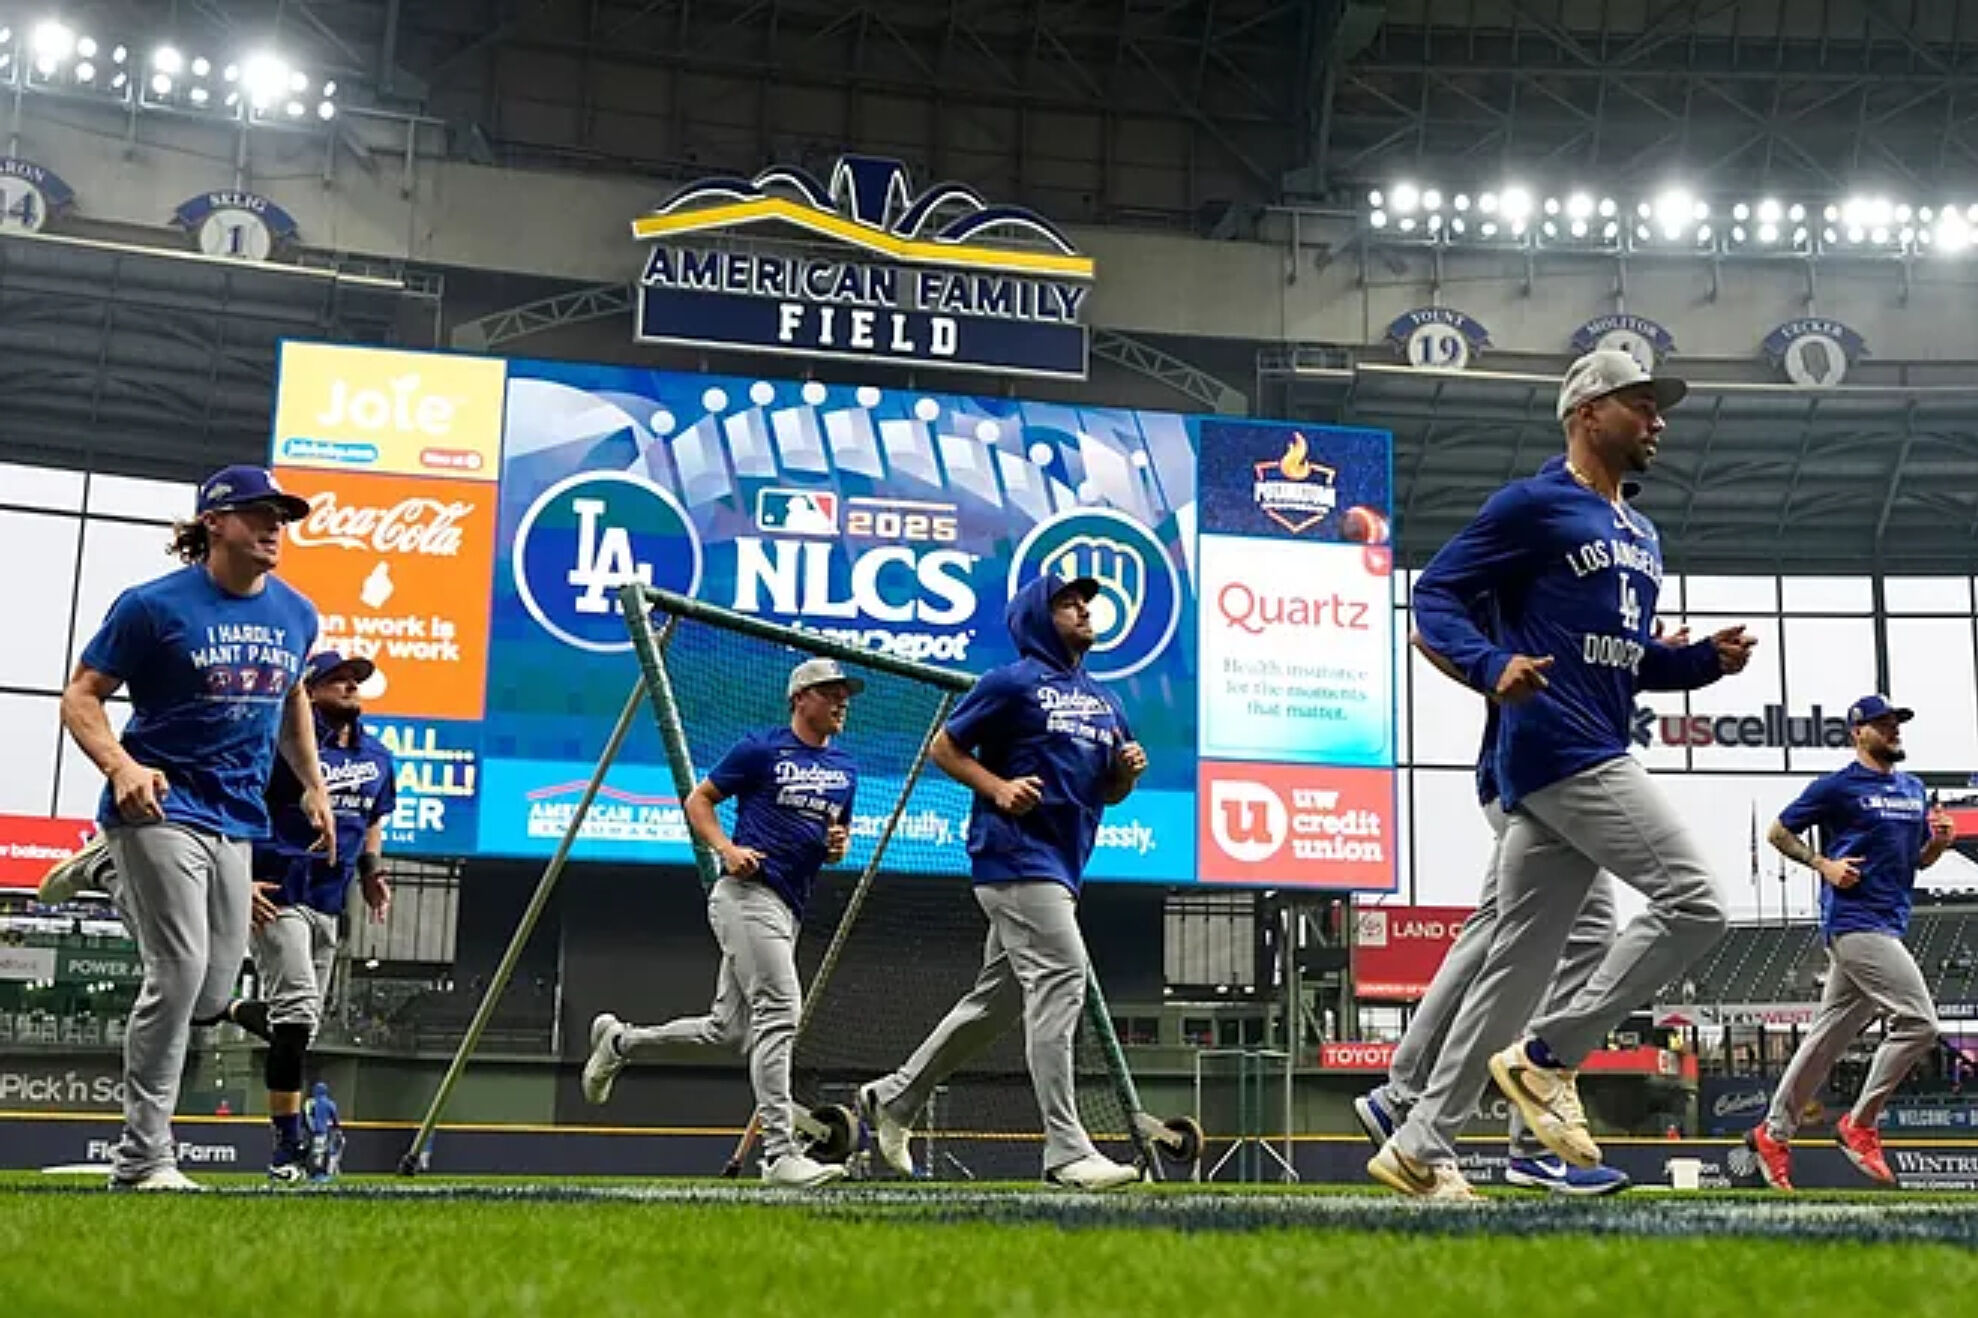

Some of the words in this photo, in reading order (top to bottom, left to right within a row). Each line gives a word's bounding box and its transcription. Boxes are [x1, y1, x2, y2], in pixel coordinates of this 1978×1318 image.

[230, 224, 248, 253] 1
[641, 246, 899, 306] AMERICAN
[916, 270, 1090, 323] FAMILY
[778, 303, 958, 356] FIELD
[1585, 316, 1659, 337] MOLITOR
[1416, 335, 1458, 364] 19
[287, 490, 475, 556] Coca-Cola
[848, 511, 958, 541] 2025
[568, 499, 653, 614] LA
[1565, 539, 1611, 577] LOS
[731, 536, 978, 626] NLCS
[1217, 581, 1370, 636] Quartz
[1618, 572, 1642, 632] LA
[206, 626, 214, 643] I
[218, 623, 286, 646] HARDLY
[352, 615, 427, 637] work
[431, 617, 456, 639] is
[190, 644, 241, 669] WANT
[387, 637, 461, 661] work
[1223, 657, 1282, 676] Health
[1037, 686, 1114, 720] Dodgers
[1225, 680, 1250, 695] for
[1253, 682, 1283, 697] the
[1286, 685, 1369, 701] moments
[1247, 701, 1281, 717] that
[773, 759, 851, 794] Dodgers
[1291, 788, 1340, 809] uw
[381, 797, 445, 831] ER
[1292, 809, 1381, 836] credit
[1291, 834, 1383, 862] union
[1392, 920, 1445, 938] LAND
[67, 958, 128, 977] POWER
[0, 1072, 62, 1101] Pick
[177, 1141, 236, 1163] Farm
